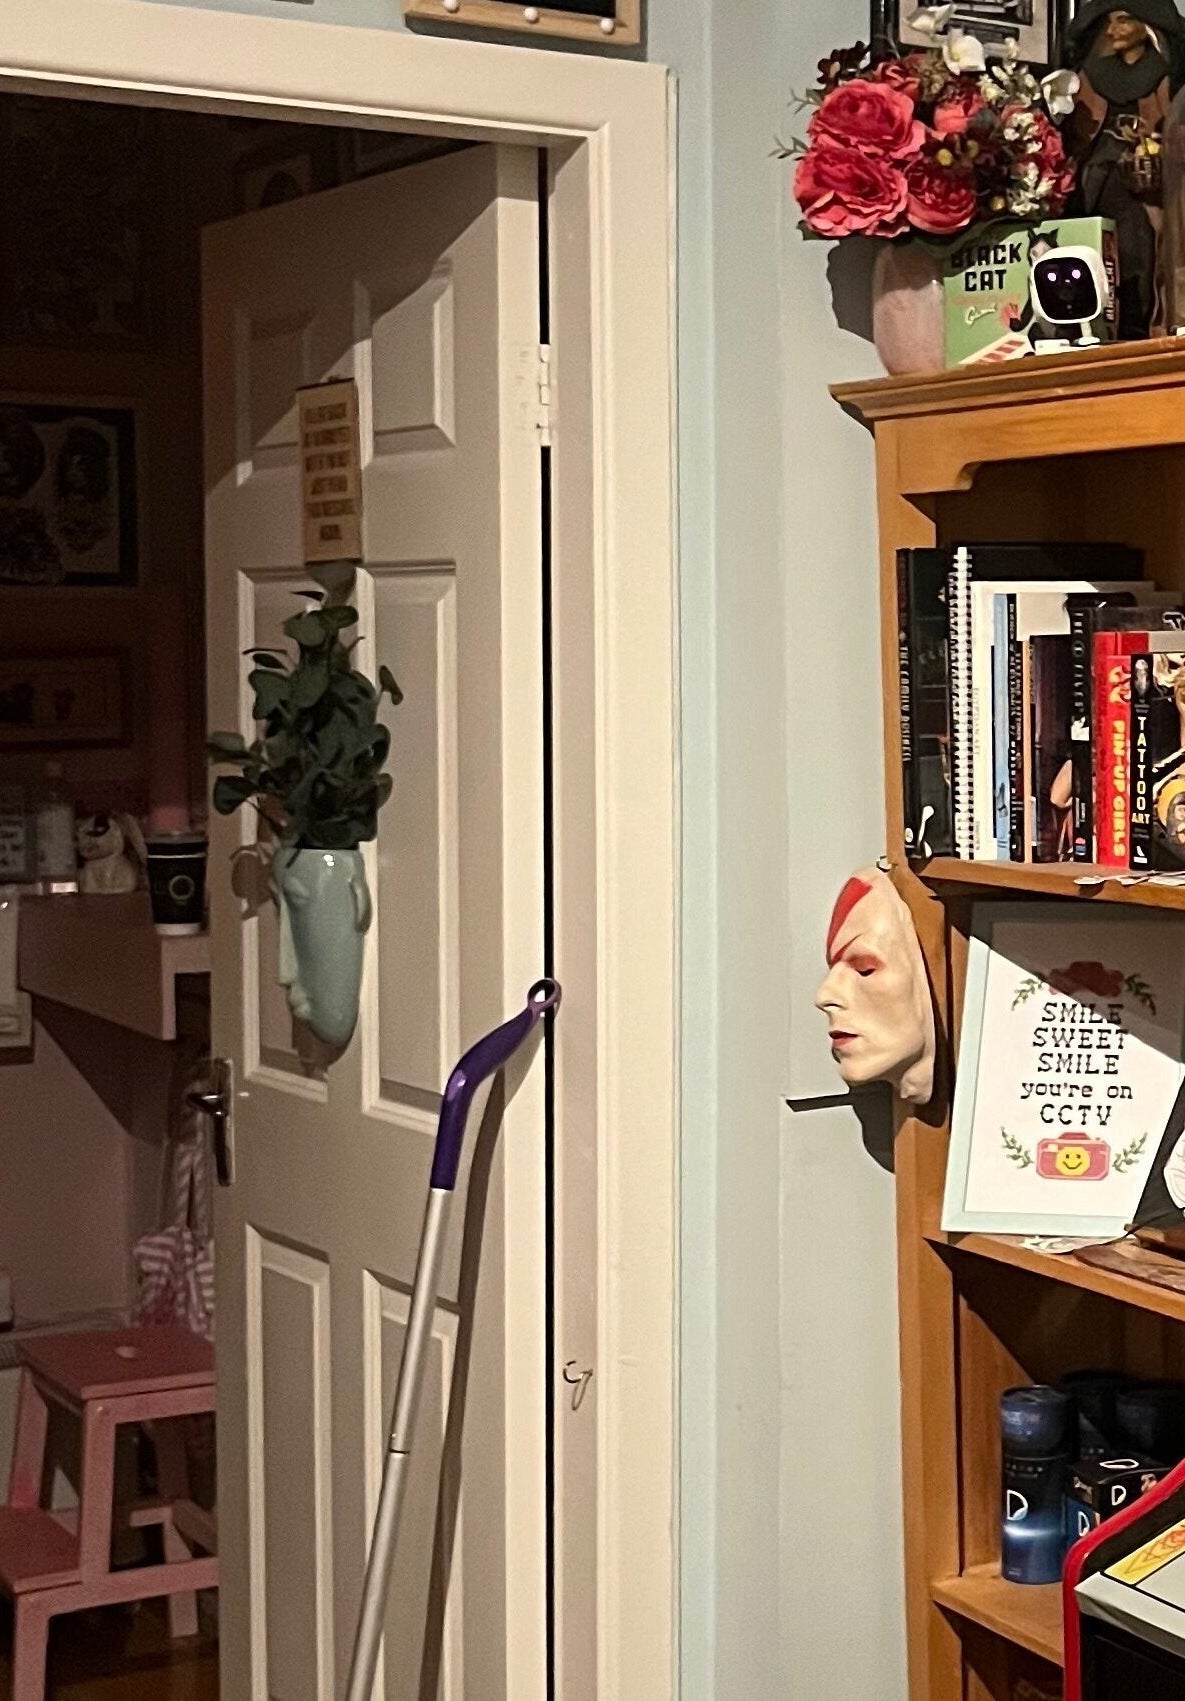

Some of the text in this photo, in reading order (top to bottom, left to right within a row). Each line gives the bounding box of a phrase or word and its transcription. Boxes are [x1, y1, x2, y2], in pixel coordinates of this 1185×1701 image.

[950, 242, 1023, 270] BLACK
[964, 269, 1007, 292] CAT
[1136, 716, 1147, 811] TATTOO
[1113, 720, 1126, 857] PIN-UP GIRLS
[1131, 812, 1150, 824] ART
[1041, 1002, 1124, 1025] SMILE
[1032, 1027, 1128, 1049] SWEET
[1037, 1052, 1120, 1075] SMILE
[1020, 1082, 1133, 1100] you're on
[1040, 1103, 1112, 1126] CCTV
